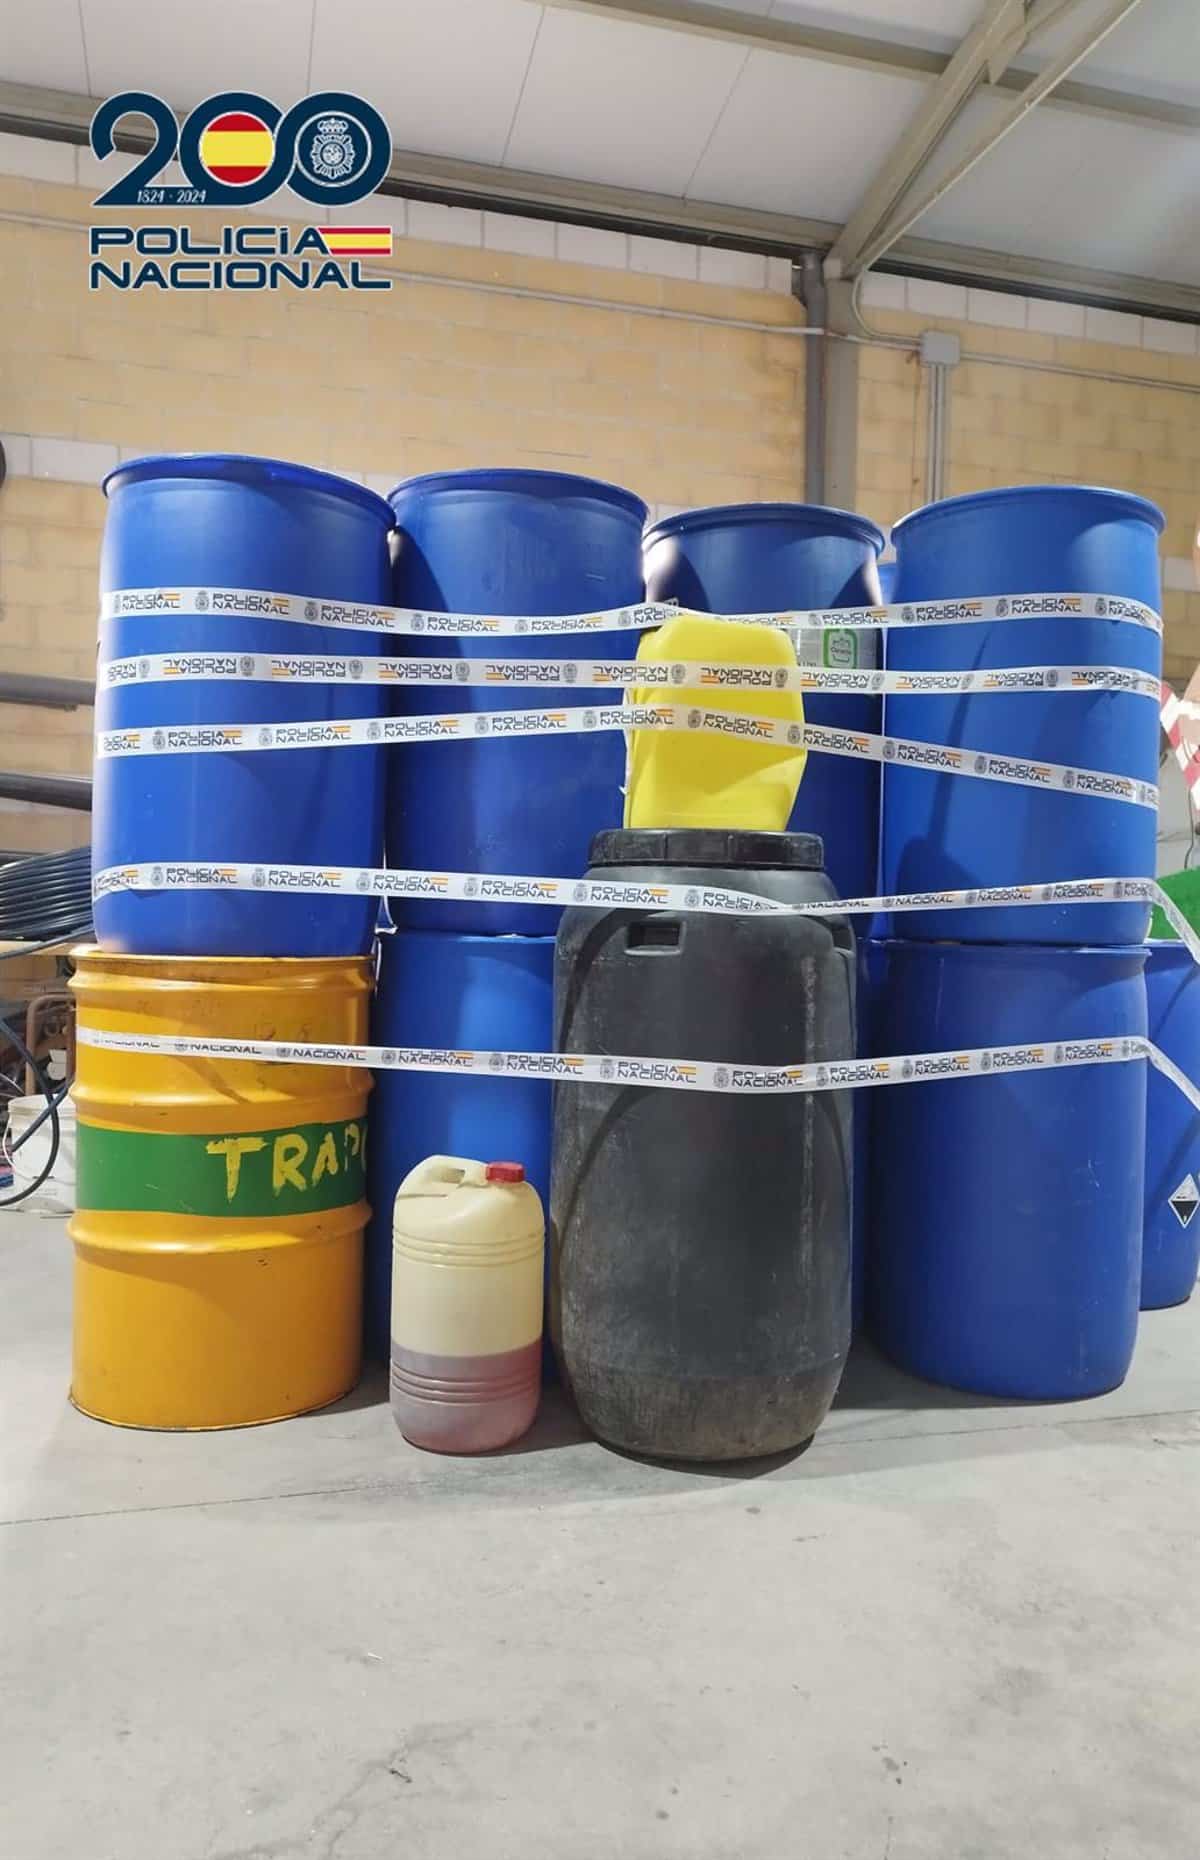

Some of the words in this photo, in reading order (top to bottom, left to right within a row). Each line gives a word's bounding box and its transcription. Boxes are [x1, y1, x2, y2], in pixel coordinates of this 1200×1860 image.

[212, 600, 288, 615] NACIONAL
[1012, 604, 1081, 614] NACIONAL
[320, 613, 394, 628] NACIONAL
[492, 722, 568, 731] NACIONAL
[600, 716, 673, 725] NACIONAL
[384, 728, 460, 737] NACIONAL
[704, 719, 774, 738] NACIONAL
[168, 738, 242, 746] NACIONAL
[276, 734, 352, 744] NACIONAL
[803, 736, 868, 753] NACIONAL
[898, 752, 960, 768] NACIONAL
[988, 767, 1050, 784] NACIONAL
[1076, 780, 1132, 797] NACIONAL
[166, 875, 238, 884] NACIONAL
[268, 878, 341, 888] NACIONAL
[373, 882, 448, 893] NACIONAL
[480, 888, 556, 899] NACIONAL
[590, 894, 668, 904] NACIONAL
[293, 1048, 366, 1061] NACIONAL
[992, 1056, 1044, 1068] NACIONAL
[506, 1062, 584, 1075] NACIONAL
[914, 1064, 969, 1076] NACIONAL
[617, 1070, 696, 1083] NACIONAL
[830, 1072, 889, 1083] NACIONAL
[205, 1123, 368, 1204] TRAP
